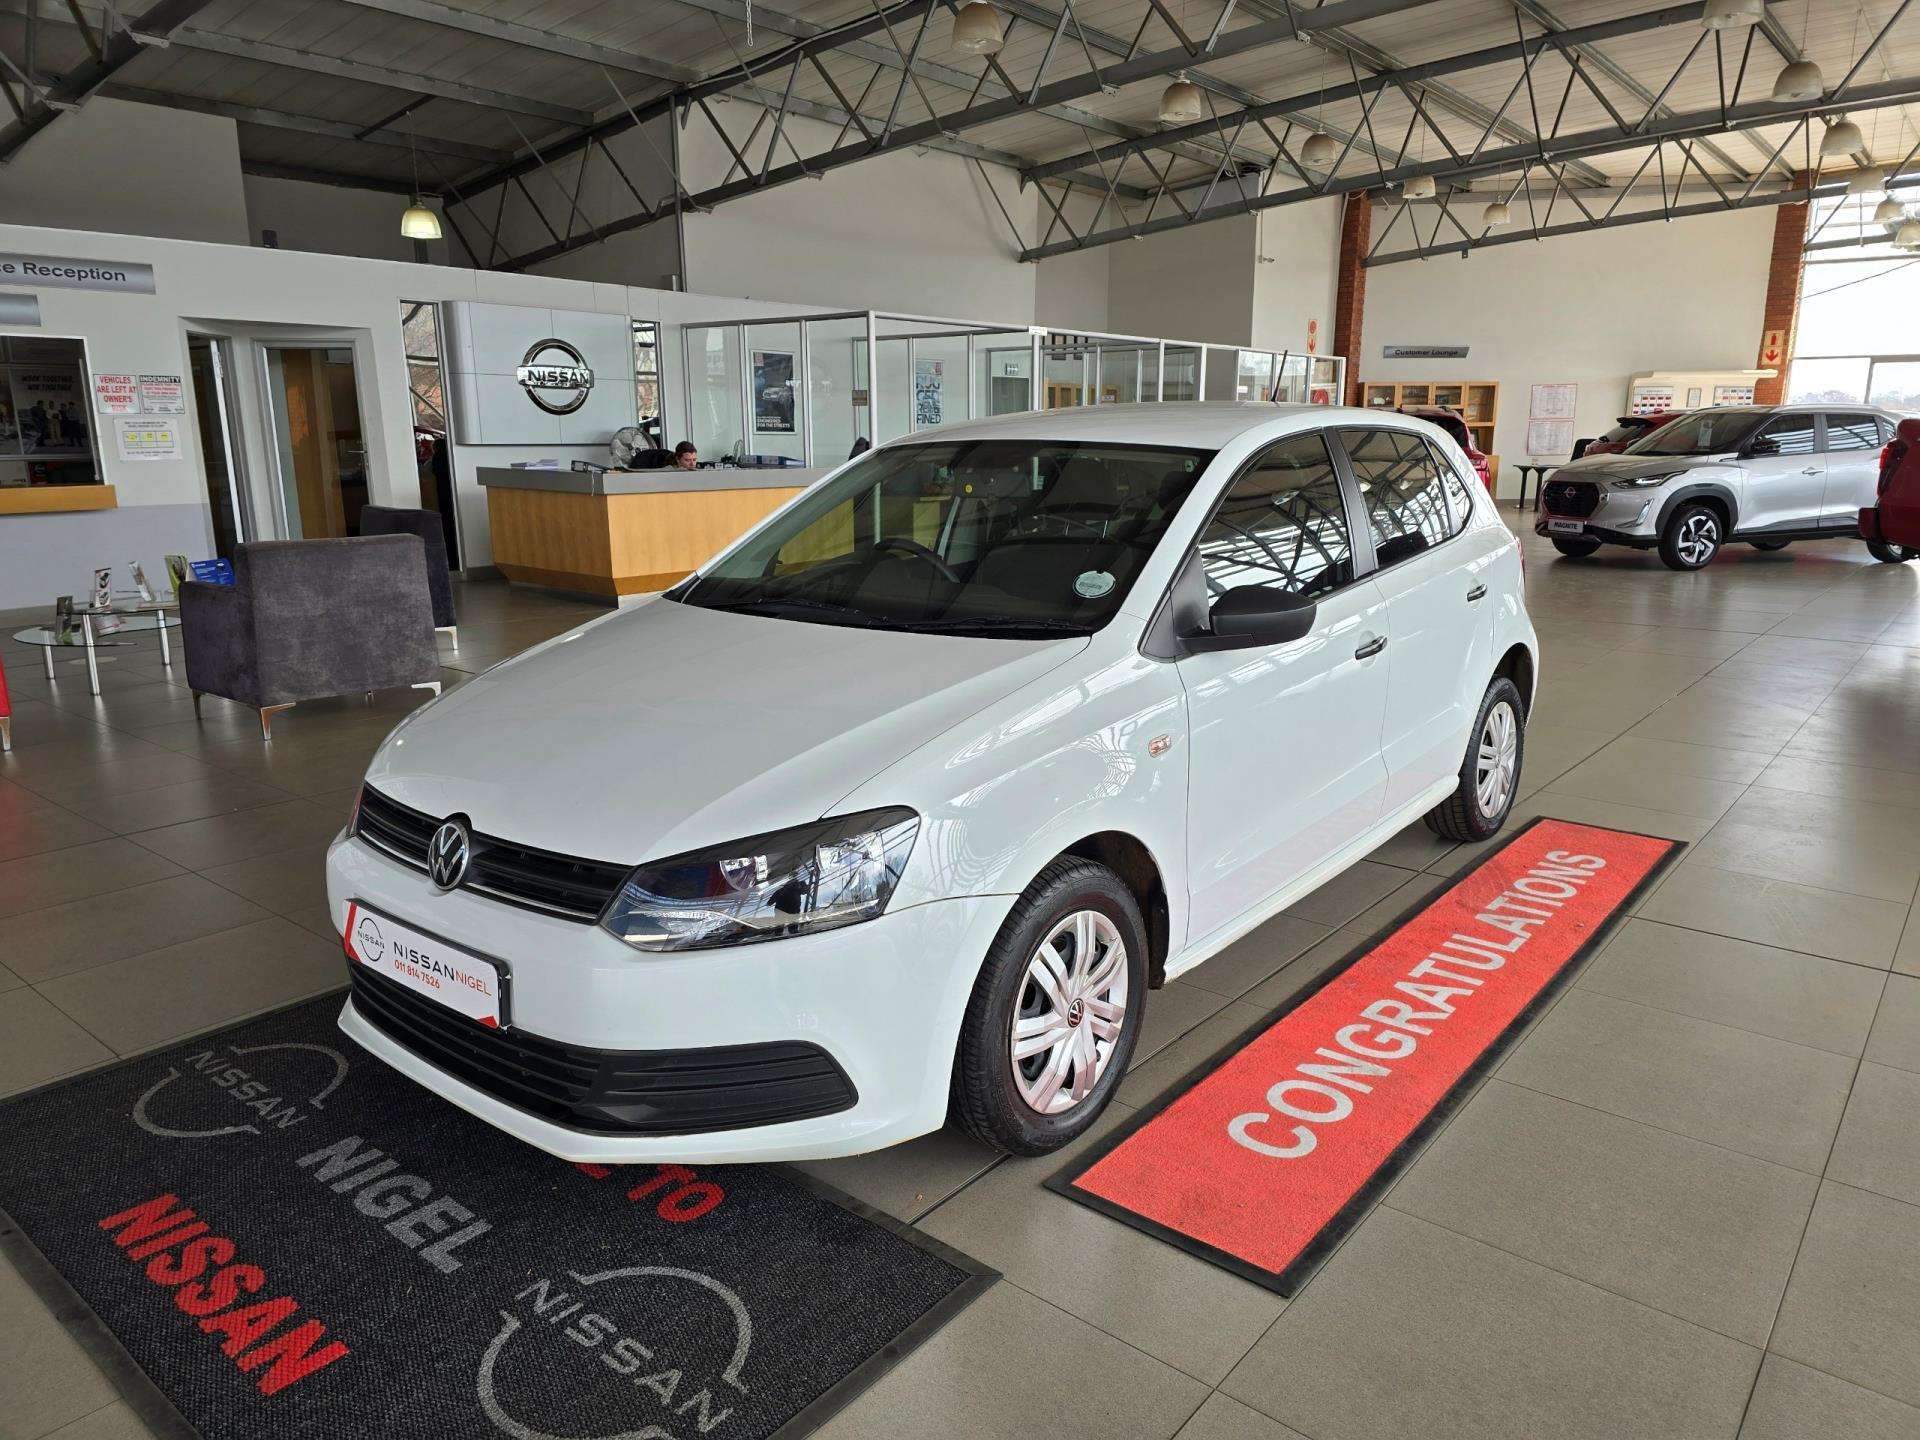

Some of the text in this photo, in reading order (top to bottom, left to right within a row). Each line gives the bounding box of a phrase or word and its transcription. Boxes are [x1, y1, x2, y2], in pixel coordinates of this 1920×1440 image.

[22, 262, 126, 281] Reception
[99, 376, 132, 384] VEHICLES
[527, 369, 589, 384] NISSAN
[97, 385, 110, 393] ARE
[916, 414, 941, 424] FINED
[1553, 521, 1578, 530] MAGNITE
[357, 930, 385, 949] NISSAN
[394, 959, 440, 989] 011 814 7526
[1227, 850, 1607, 1158] CONGRATULATIONS
[185, 1050, 308, 1130] NISSAN
[299, 1134, 495, 1275] NIGEL
[99, 1193, 350, 1396] NISSAN
[514, 1278, 734, 1432] NISSAN
